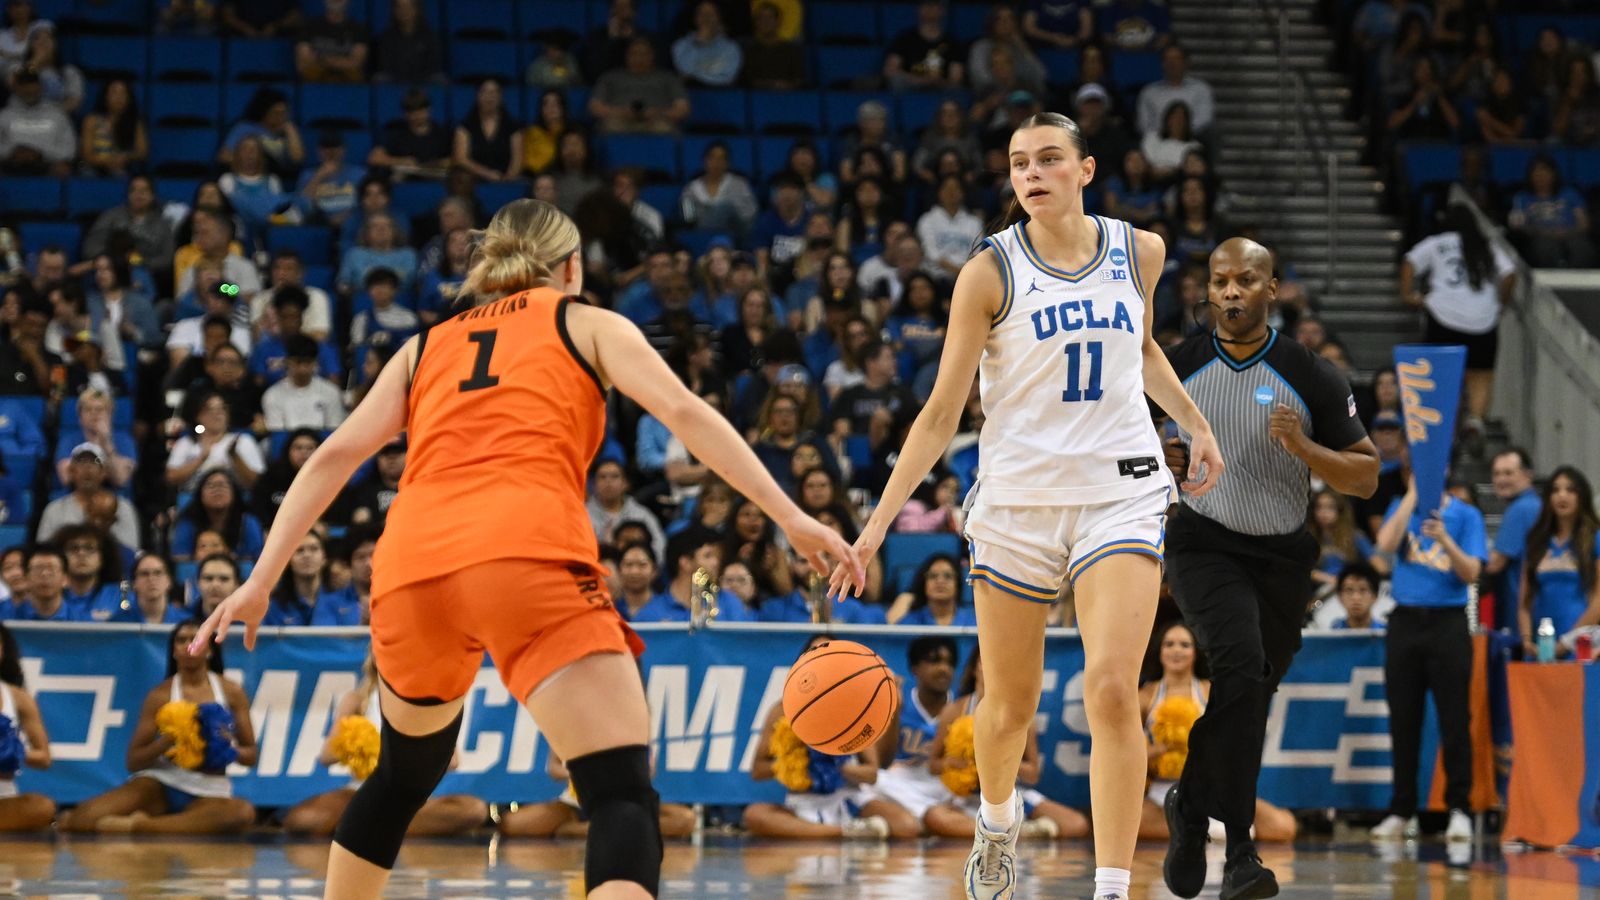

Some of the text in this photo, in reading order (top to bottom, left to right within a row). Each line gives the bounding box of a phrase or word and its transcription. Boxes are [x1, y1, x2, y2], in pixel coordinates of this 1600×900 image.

[1031, 299, 1135, 341] UCLA
[458, 328, 500, 393] 1
[1062, 341, 1104, 402] 11
